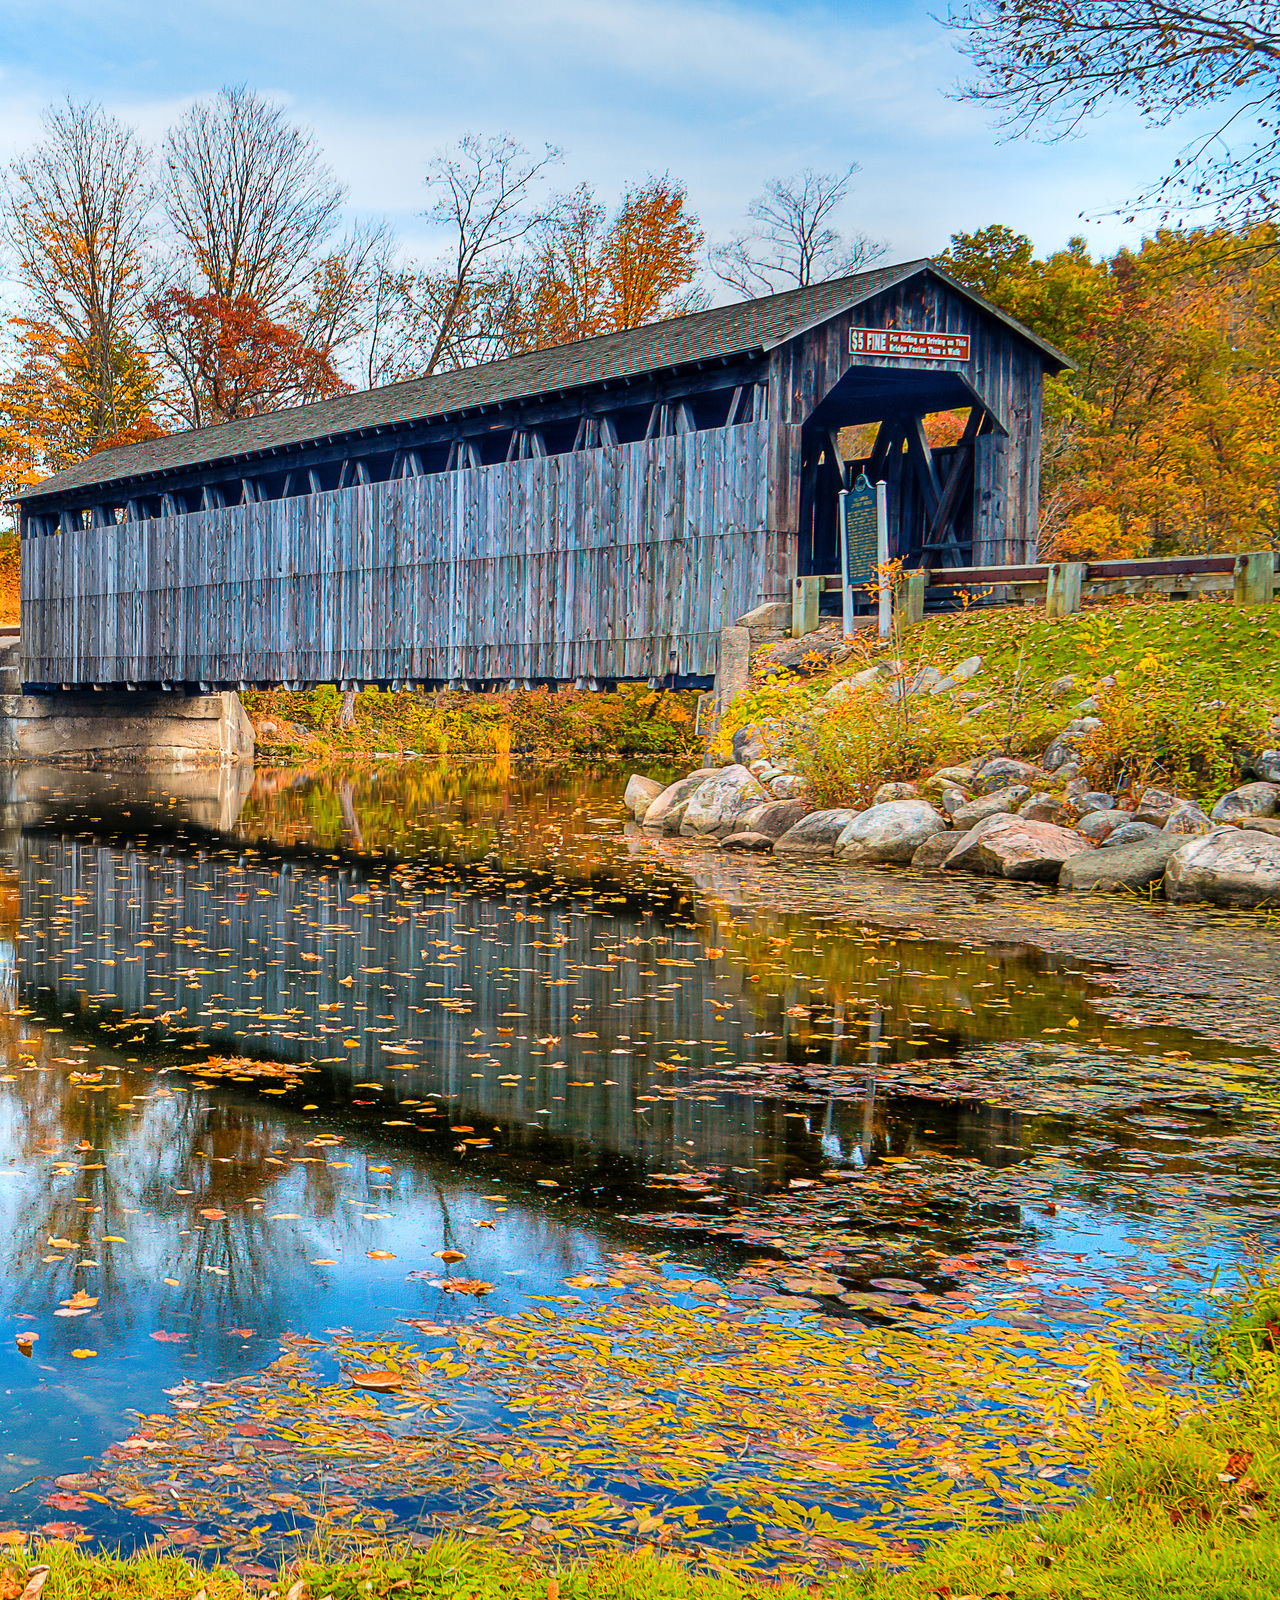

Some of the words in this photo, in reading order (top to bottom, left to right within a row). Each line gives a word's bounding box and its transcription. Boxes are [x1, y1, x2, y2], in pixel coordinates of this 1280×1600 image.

[852, 331, 864, 351] $5
[867, 333, 887, 351] FINE
[901, 335, 918, 344] Riding
[927, 337, 946, 346] Driving
[890, 344, 907, 353] Bridge
[909, 345, 926, 353] Faster
